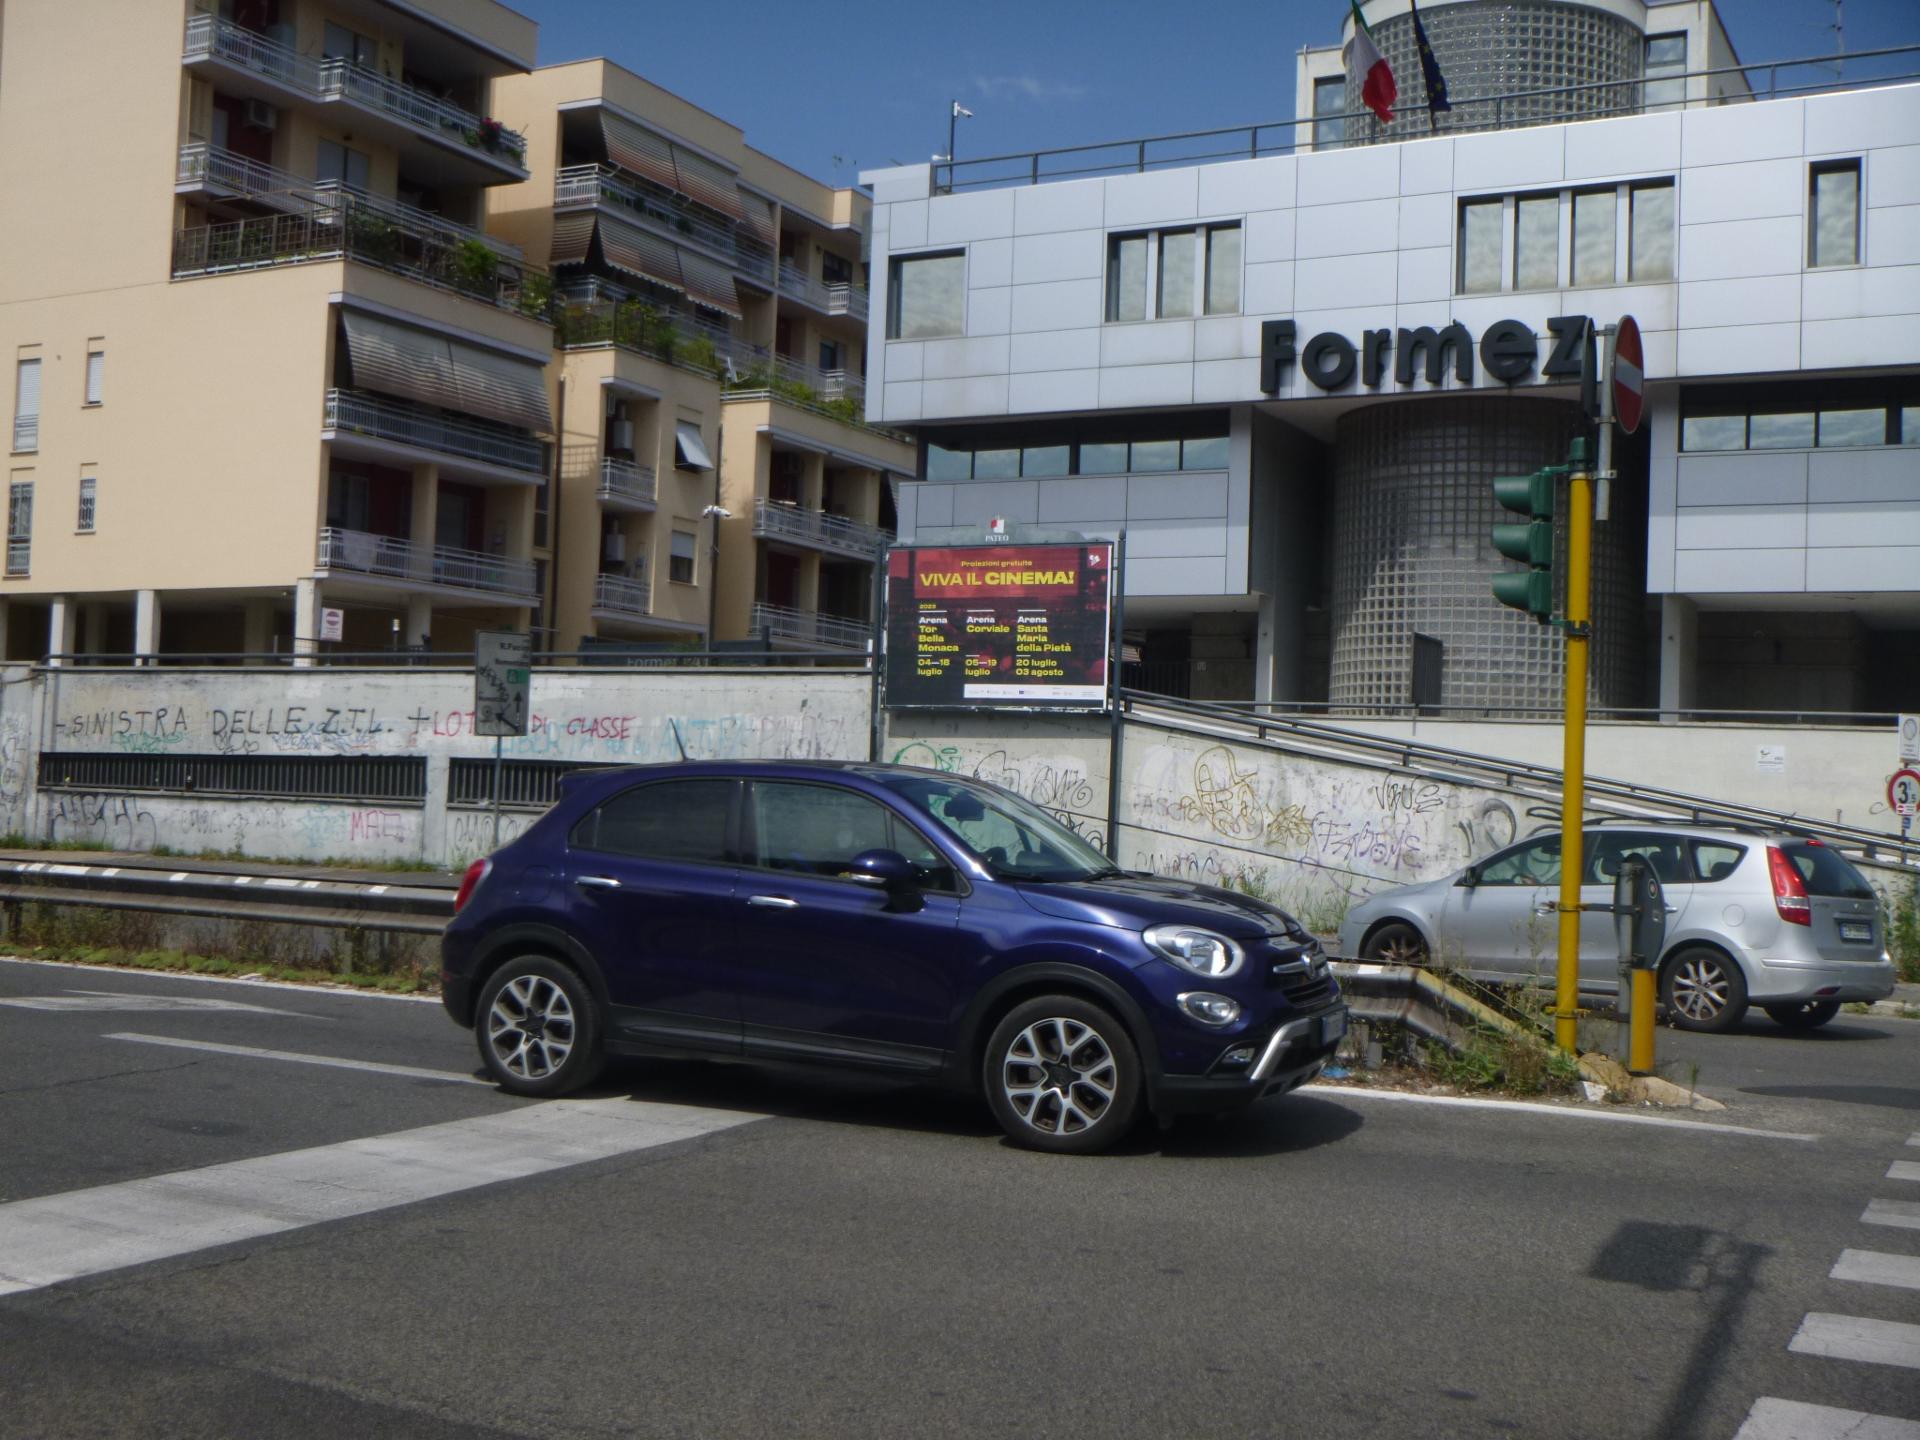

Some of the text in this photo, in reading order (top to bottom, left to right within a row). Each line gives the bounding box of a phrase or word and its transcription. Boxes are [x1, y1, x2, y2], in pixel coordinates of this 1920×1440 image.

[1260, 315, 1588, 394] Formez
[920, 571, 1075, 586] VIVA IL CINEMA!
[919, 616, 948, 624] Arena
[966, 616, 996, 624] Arena
[1017, 616, 1047, 624] Arena
[919, 625, 938, 633] Tor
[966, 624, 1010, 633] Corviale
[1017, 624, 1048, 633] Santa
[918, 634, 945, 643] Bella
[1016, 634, 1048, 642] Maria
[918, 644, 960, 652] Monaca
[1016, 642, 1072, 652] della Pietà
[1015, 658, 1057, 668] 20 luglio
[917, 668, 943, 677] luglio
[965, 668, 991, 677] luglio
[1015, 668, 1064, 677] 03 agosto
[213, 707, 306, 735] DELLE
[531, 714, 548, 733] DI
[567, 716, 638, 740] CLASSE
